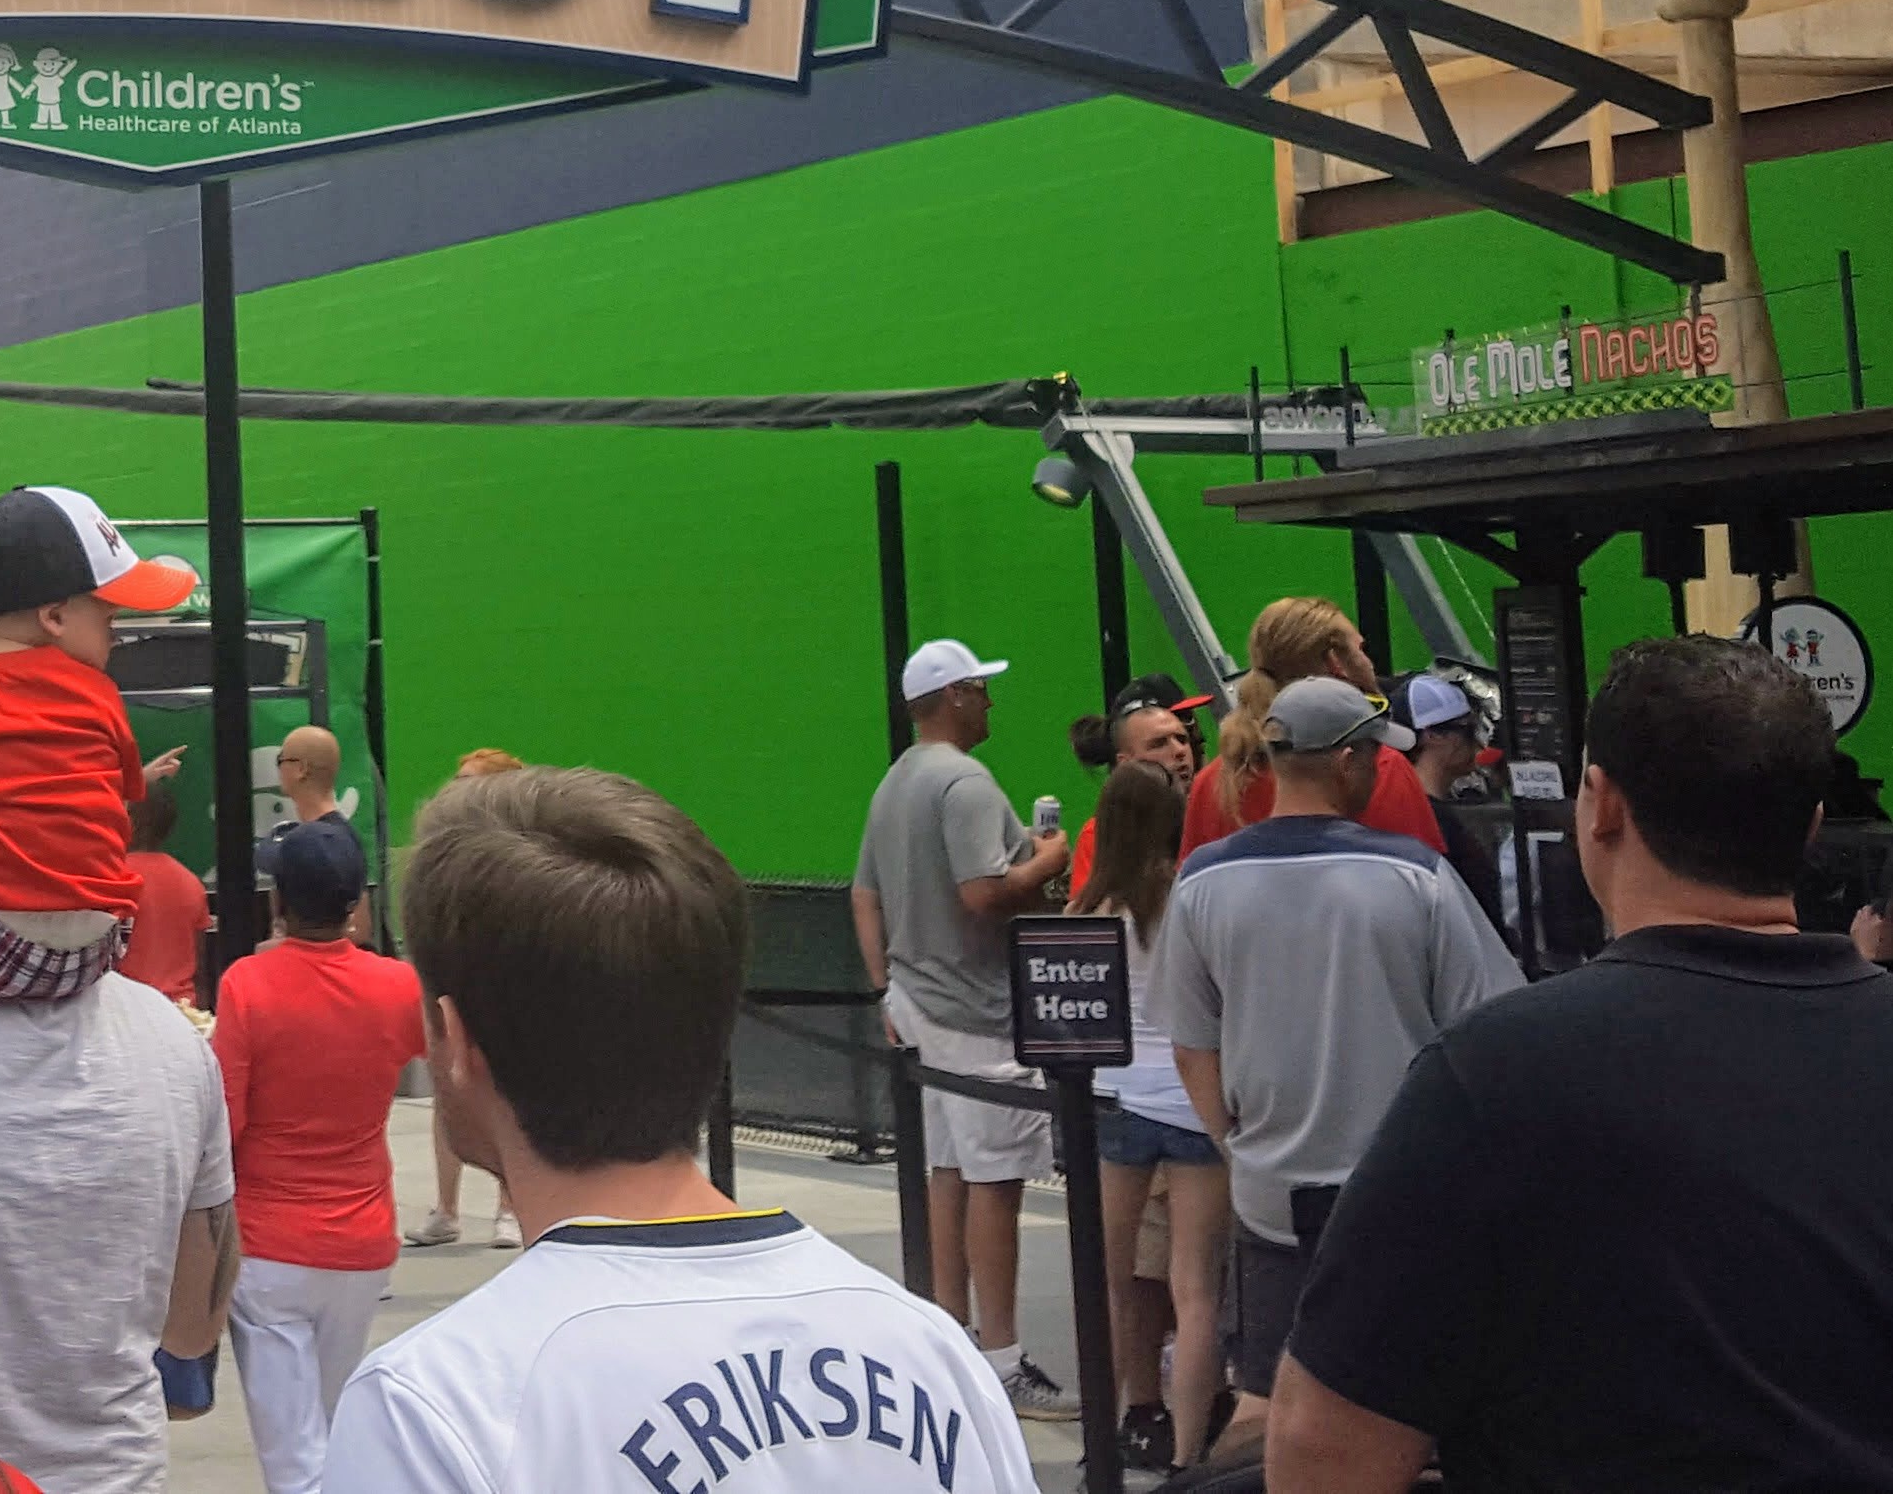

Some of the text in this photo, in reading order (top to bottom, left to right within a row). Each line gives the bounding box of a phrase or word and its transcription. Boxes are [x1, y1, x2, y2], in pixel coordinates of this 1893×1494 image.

[77, 70, 303, 112] Children's
[79, 114, 302, 136] Healthcare of Atlanta
[1429, 313, 1720, 406] OLE MOLE NACHOS
[1028, 957, 1110, 983] Enter
[1035, 994, 1108, 1020] Here
[619, 1347, 962, 1494] ERIKSEN
